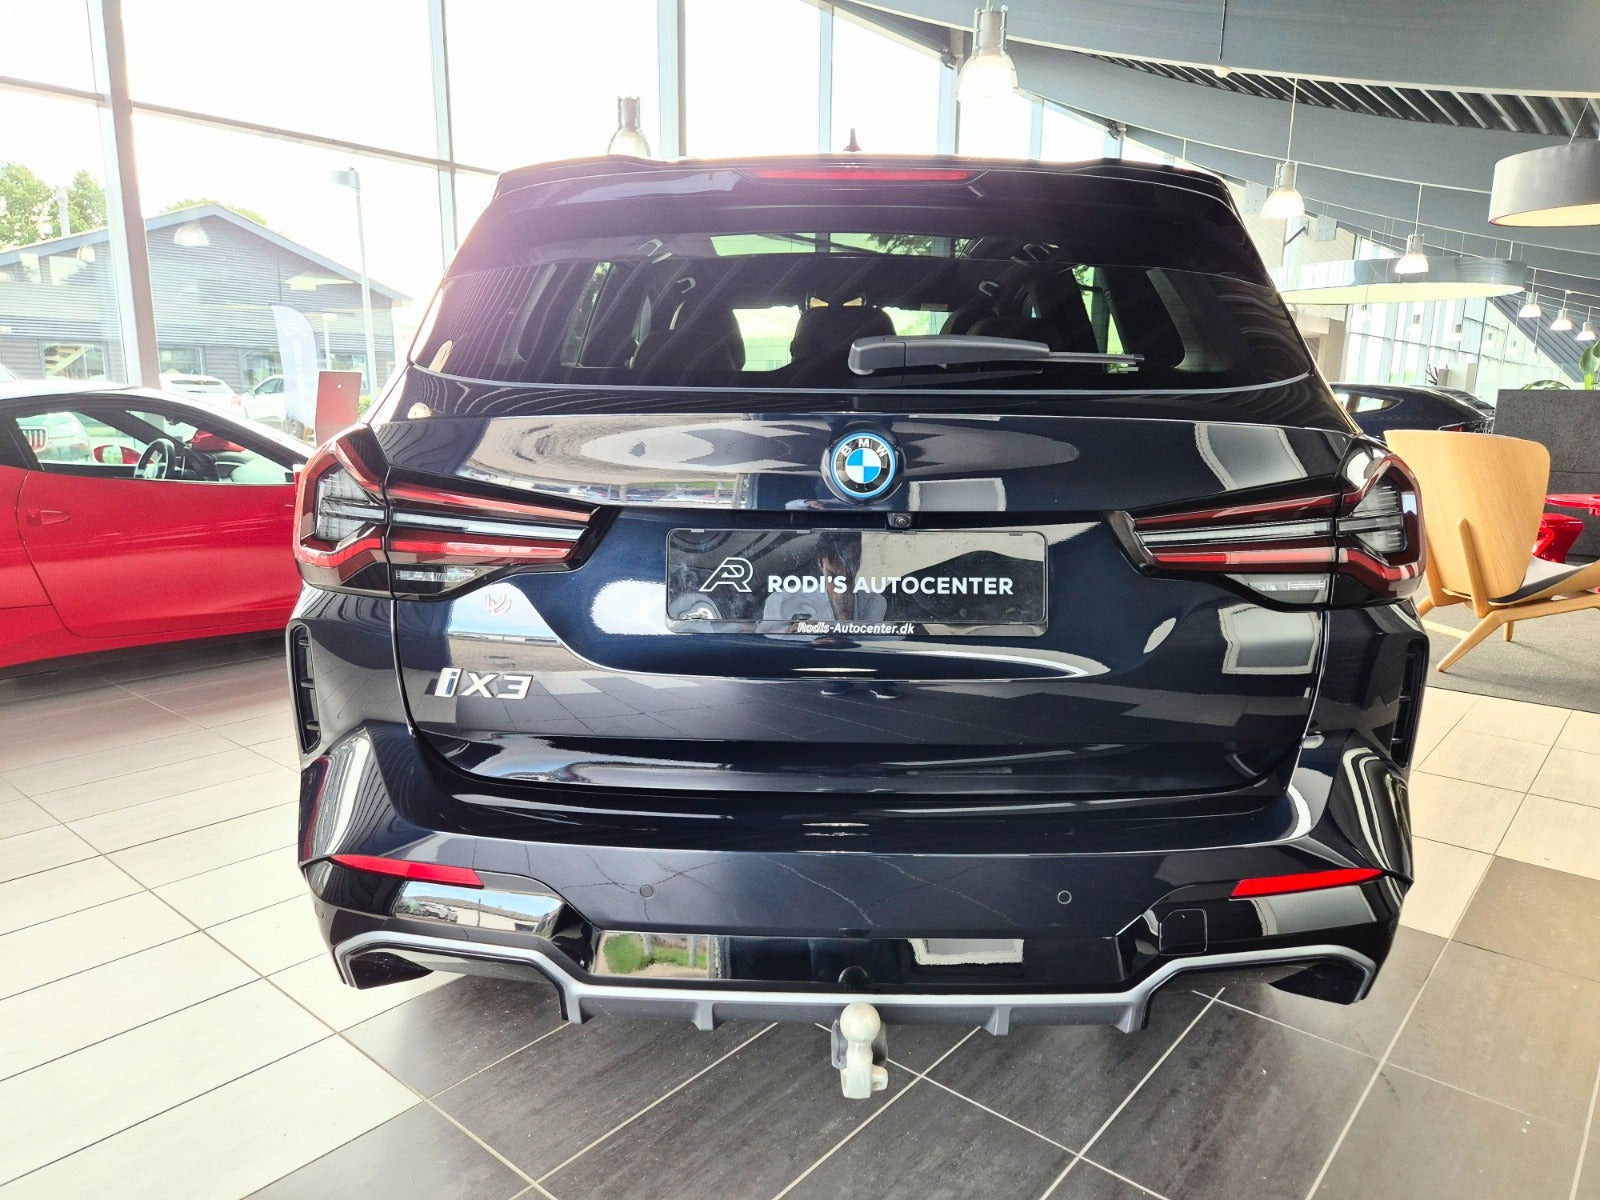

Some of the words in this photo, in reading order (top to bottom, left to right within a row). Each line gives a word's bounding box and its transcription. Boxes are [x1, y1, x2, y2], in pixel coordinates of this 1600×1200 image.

[840, 438, 889, 458] BMW
[767, 575, 848, 595] RODI'S
[853, 575, 1014, 596] AUTOCENTER
